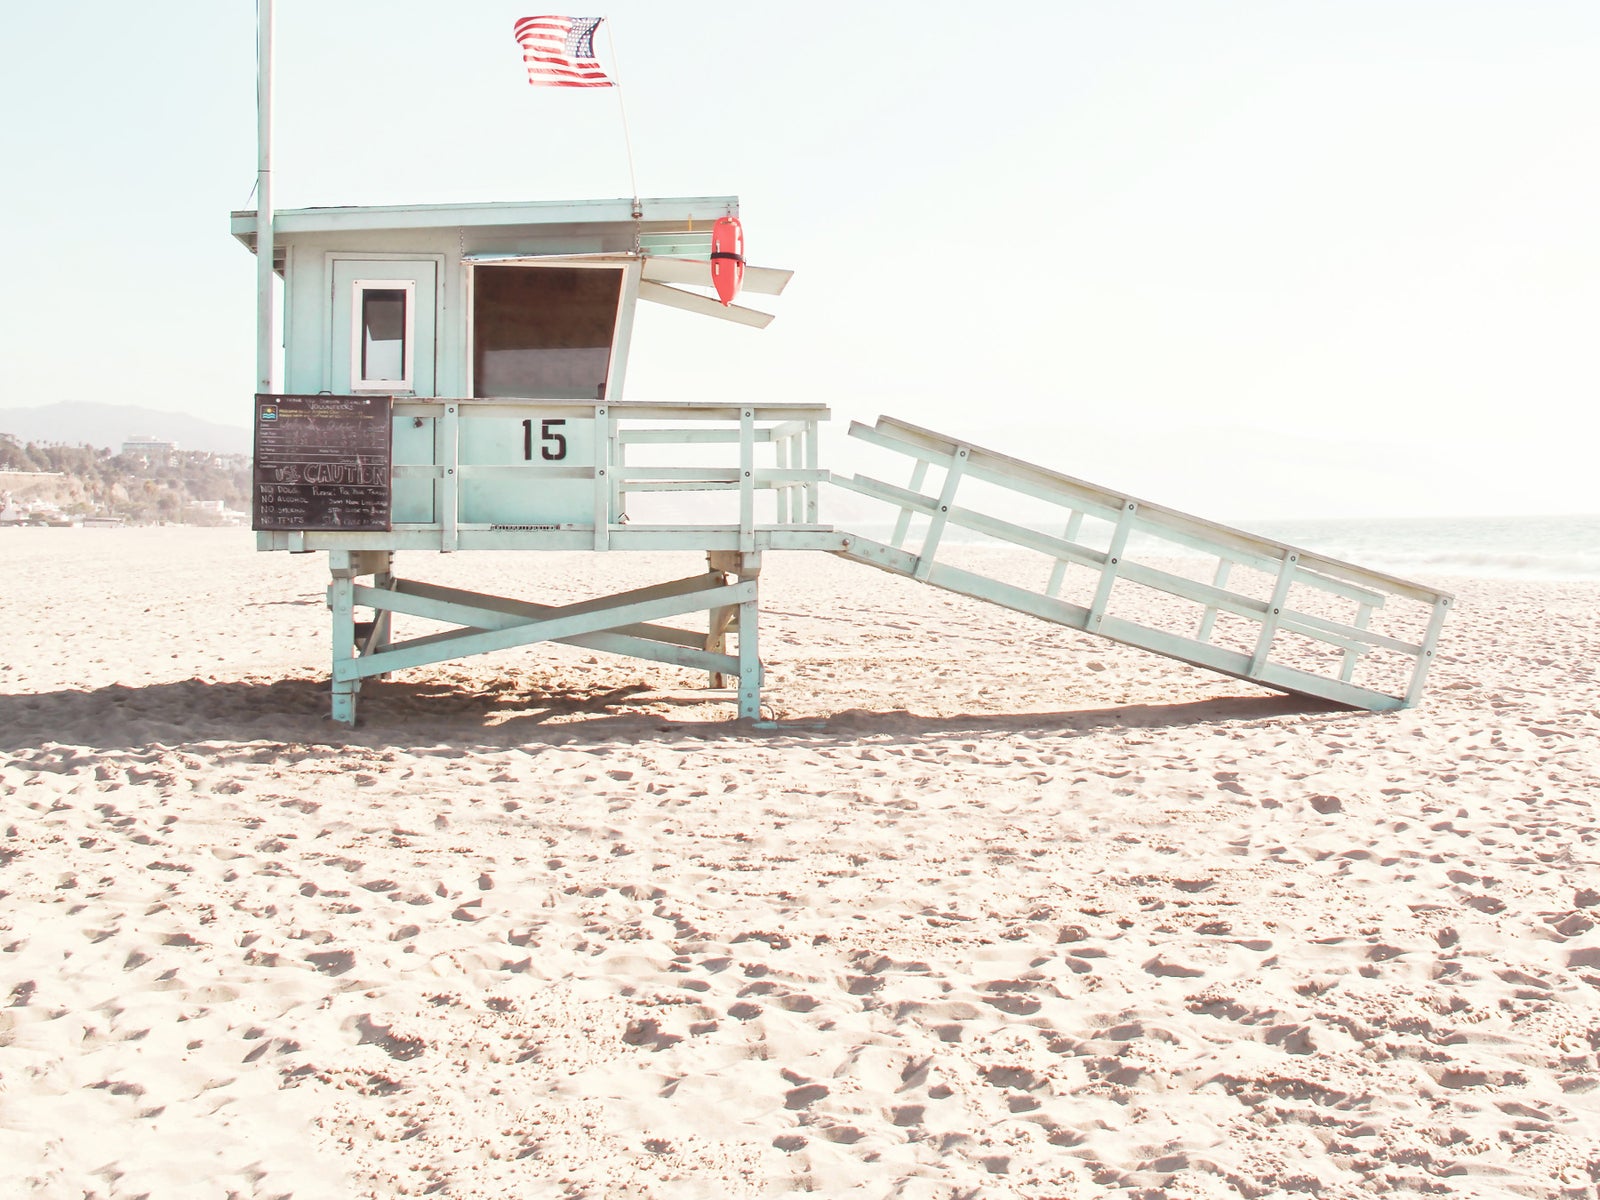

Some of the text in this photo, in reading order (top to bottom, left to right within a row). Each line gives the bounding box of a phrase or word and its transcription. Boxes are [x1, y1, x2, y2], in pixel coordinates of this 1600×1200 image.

[522, 419, 567, 461] 15
[275, 463, 387, 487] USE CAUTION
[260, 485, 274, 493] NO
[261, 495, 274, 503] NO
[260, 505, 275, 514] NO
[260, 516, 274, 525] NO
